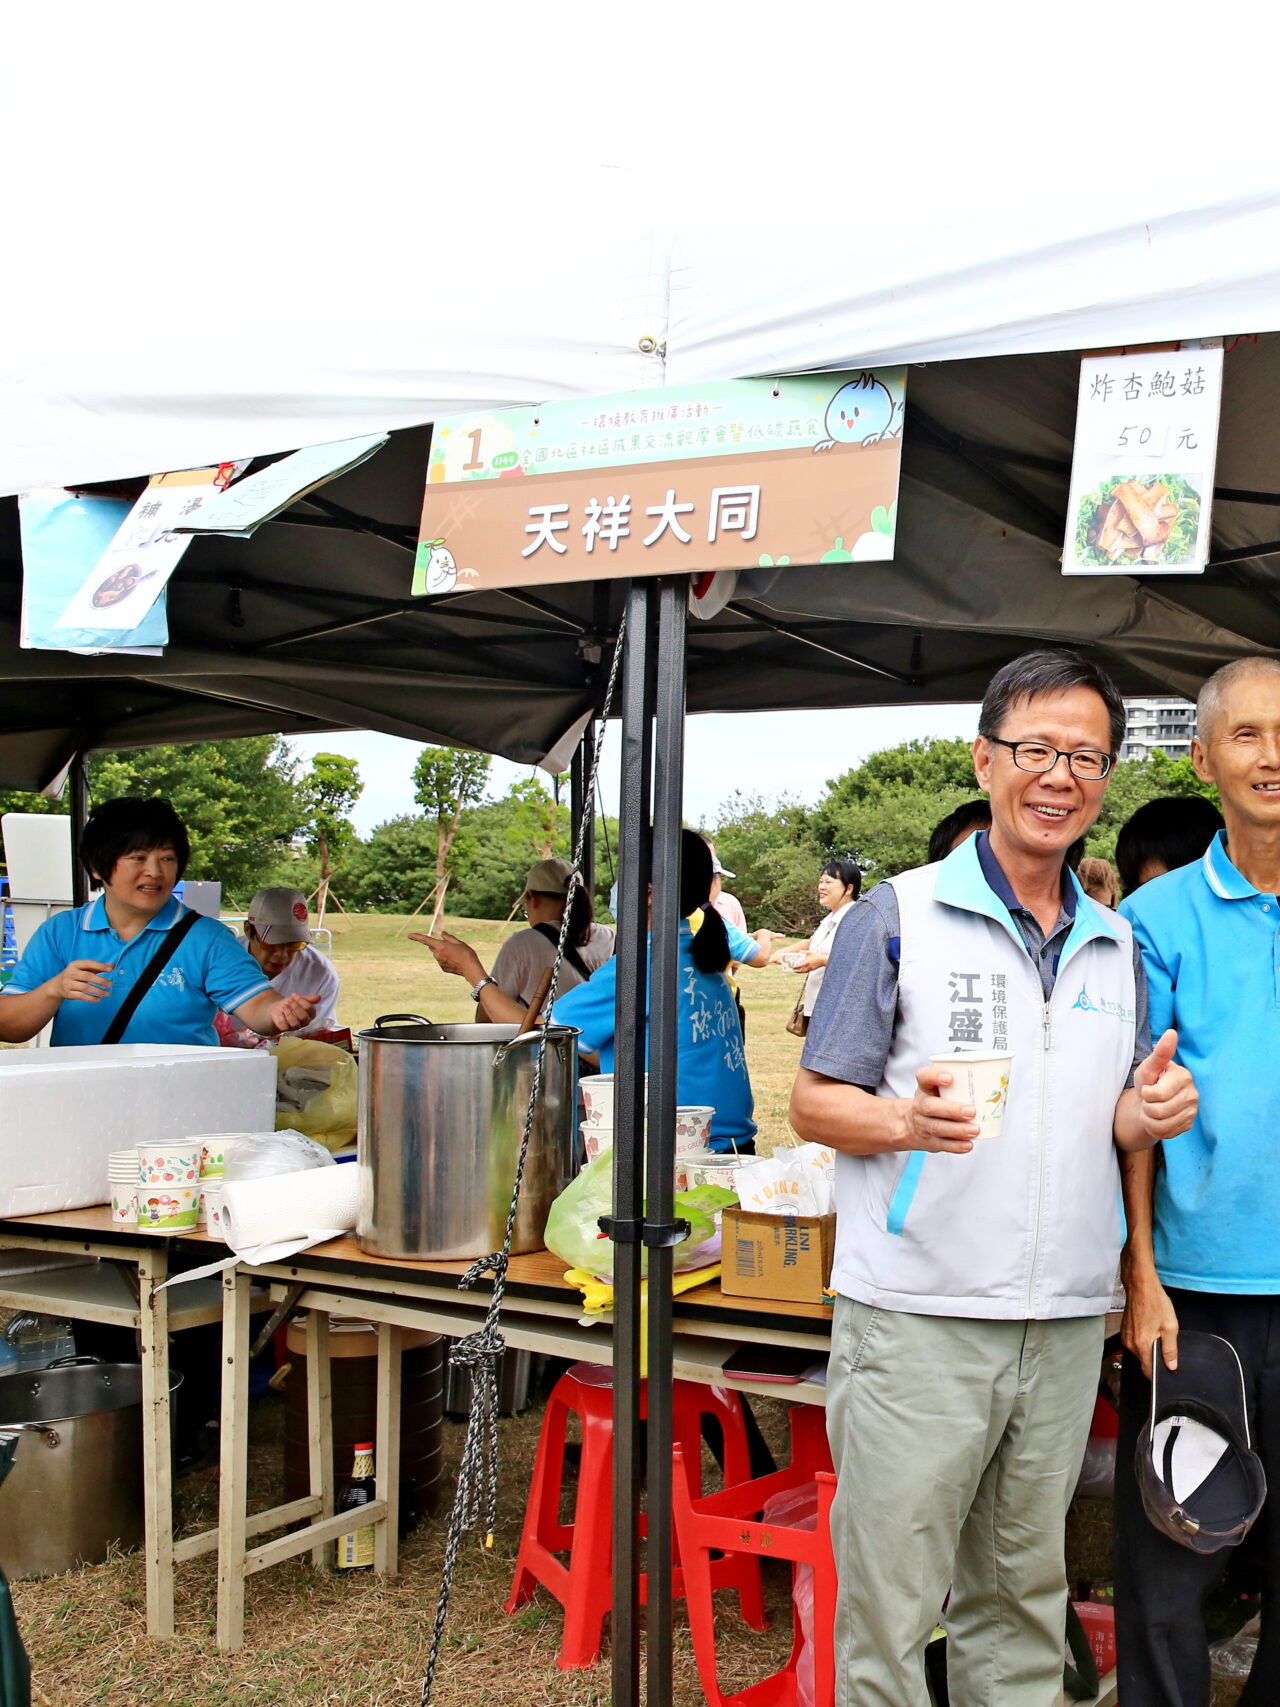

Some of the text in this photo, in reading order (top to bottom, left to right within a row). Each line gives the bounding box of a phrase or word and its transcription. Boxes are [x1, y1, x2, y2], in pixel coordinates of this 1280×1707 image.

[1089, 366, 1208, 403] 炸杏鮑菇
[462, 428, 484, 471] 1
[520, 483, 764, 559] 天祥大同
[946, 970, 984, 1053] 江盛
[990, 973, 1009, 1051] 環境保護局
